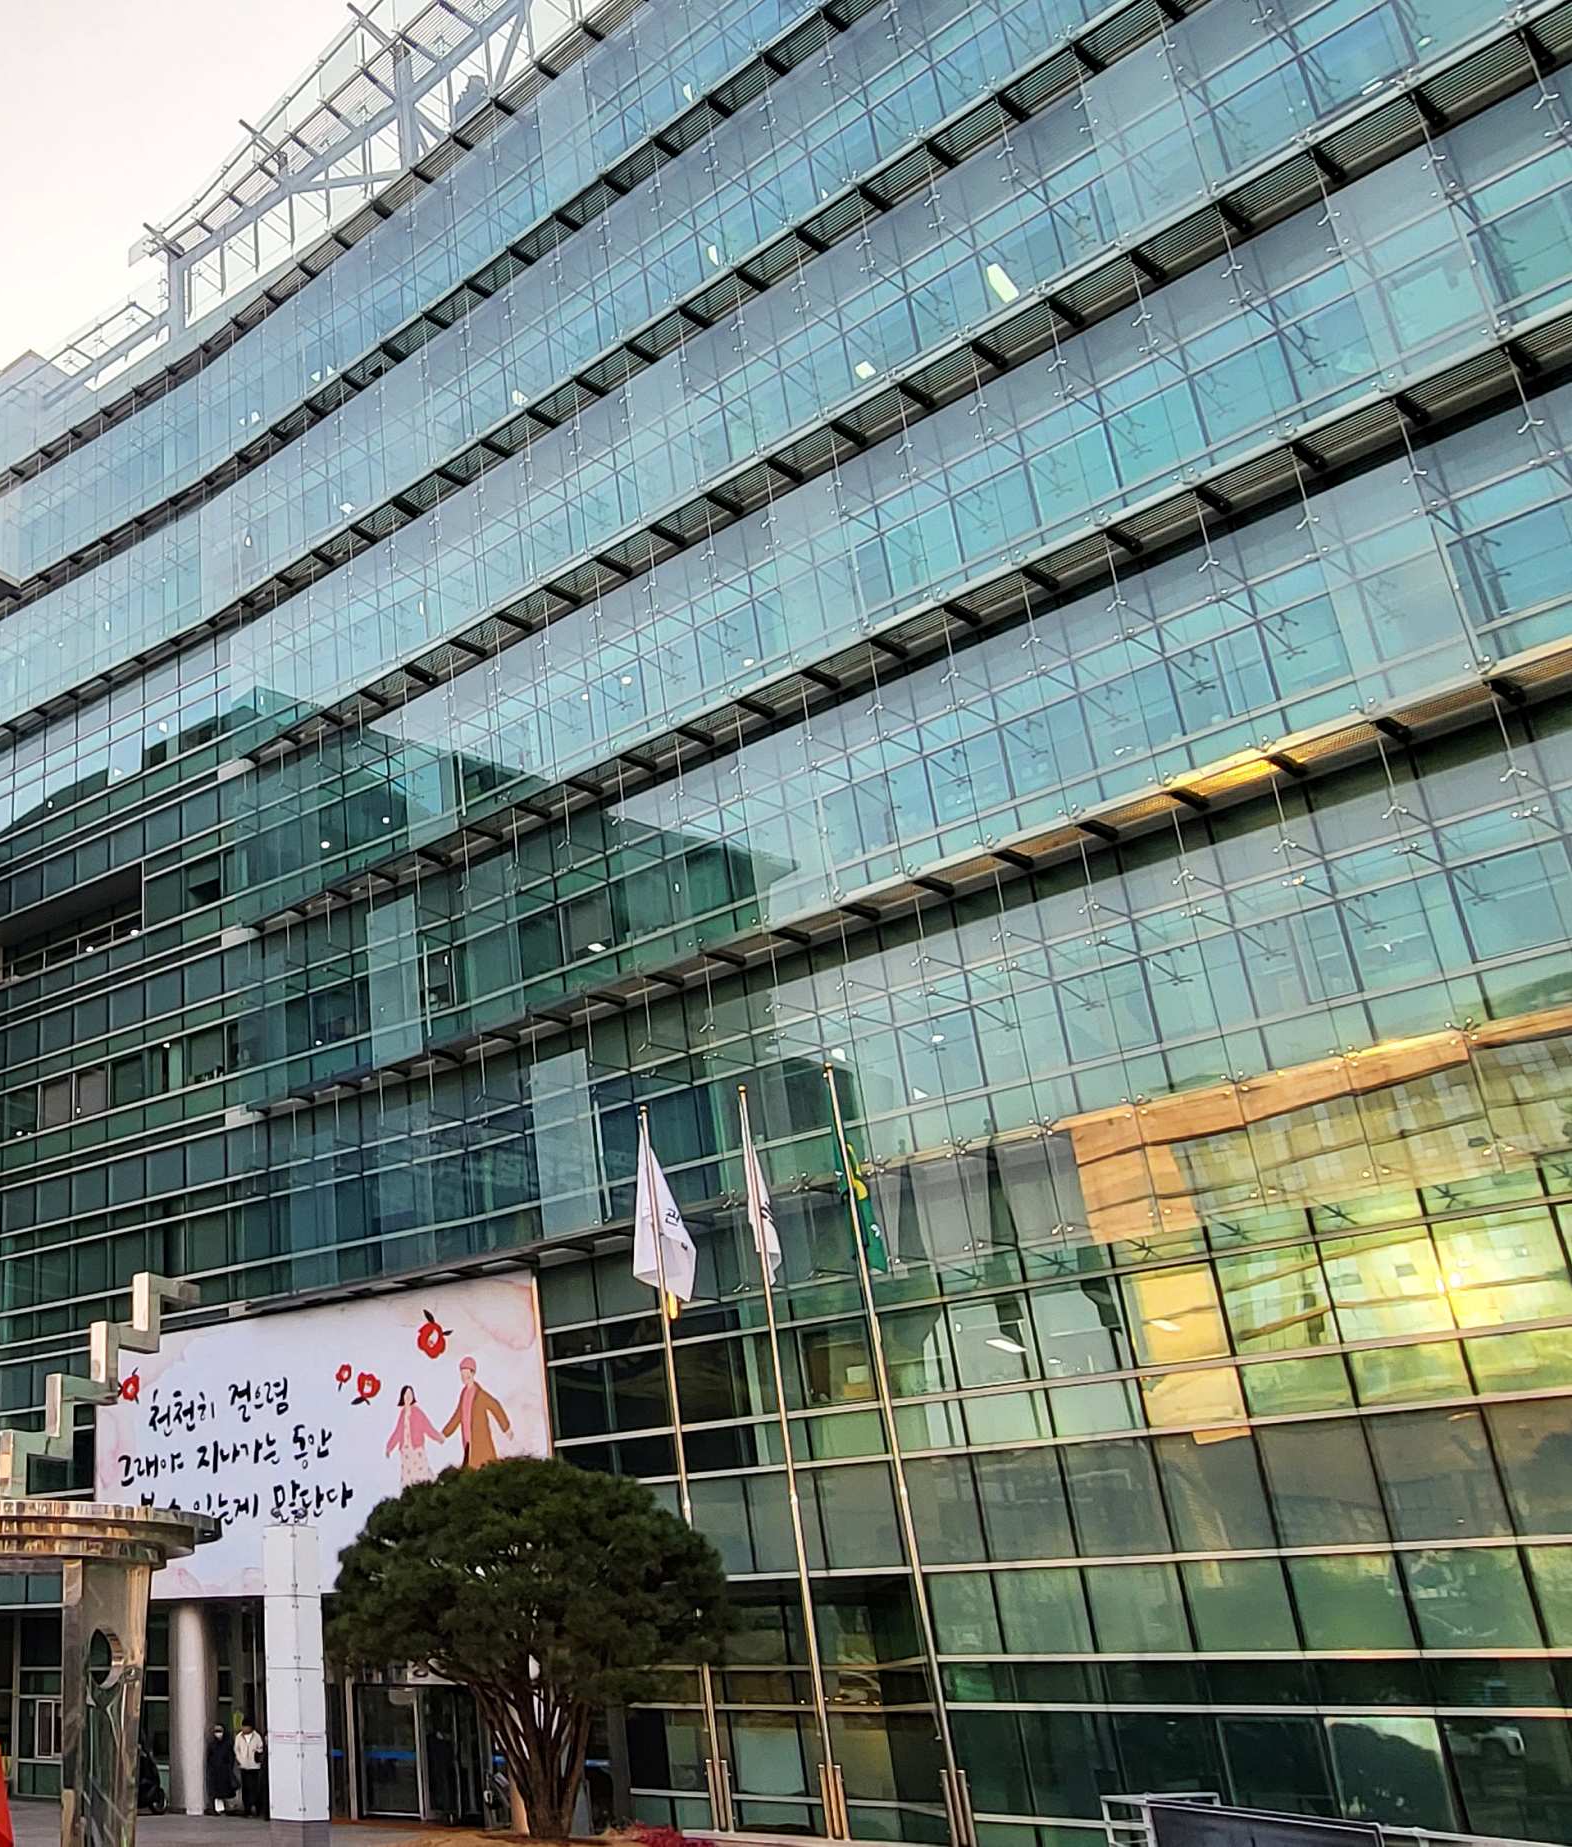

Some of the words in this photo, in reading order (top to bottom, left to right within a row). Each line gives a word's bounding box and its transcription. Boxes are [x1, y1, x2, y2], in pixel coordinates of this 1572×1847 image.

[148, 1388, 215, 1437] 천천히
[118, 1452, 184, 1487] 그래야
[196, 1432, 280, 1474] 지나가는
[292, 1424, 333, 1470] 동안
